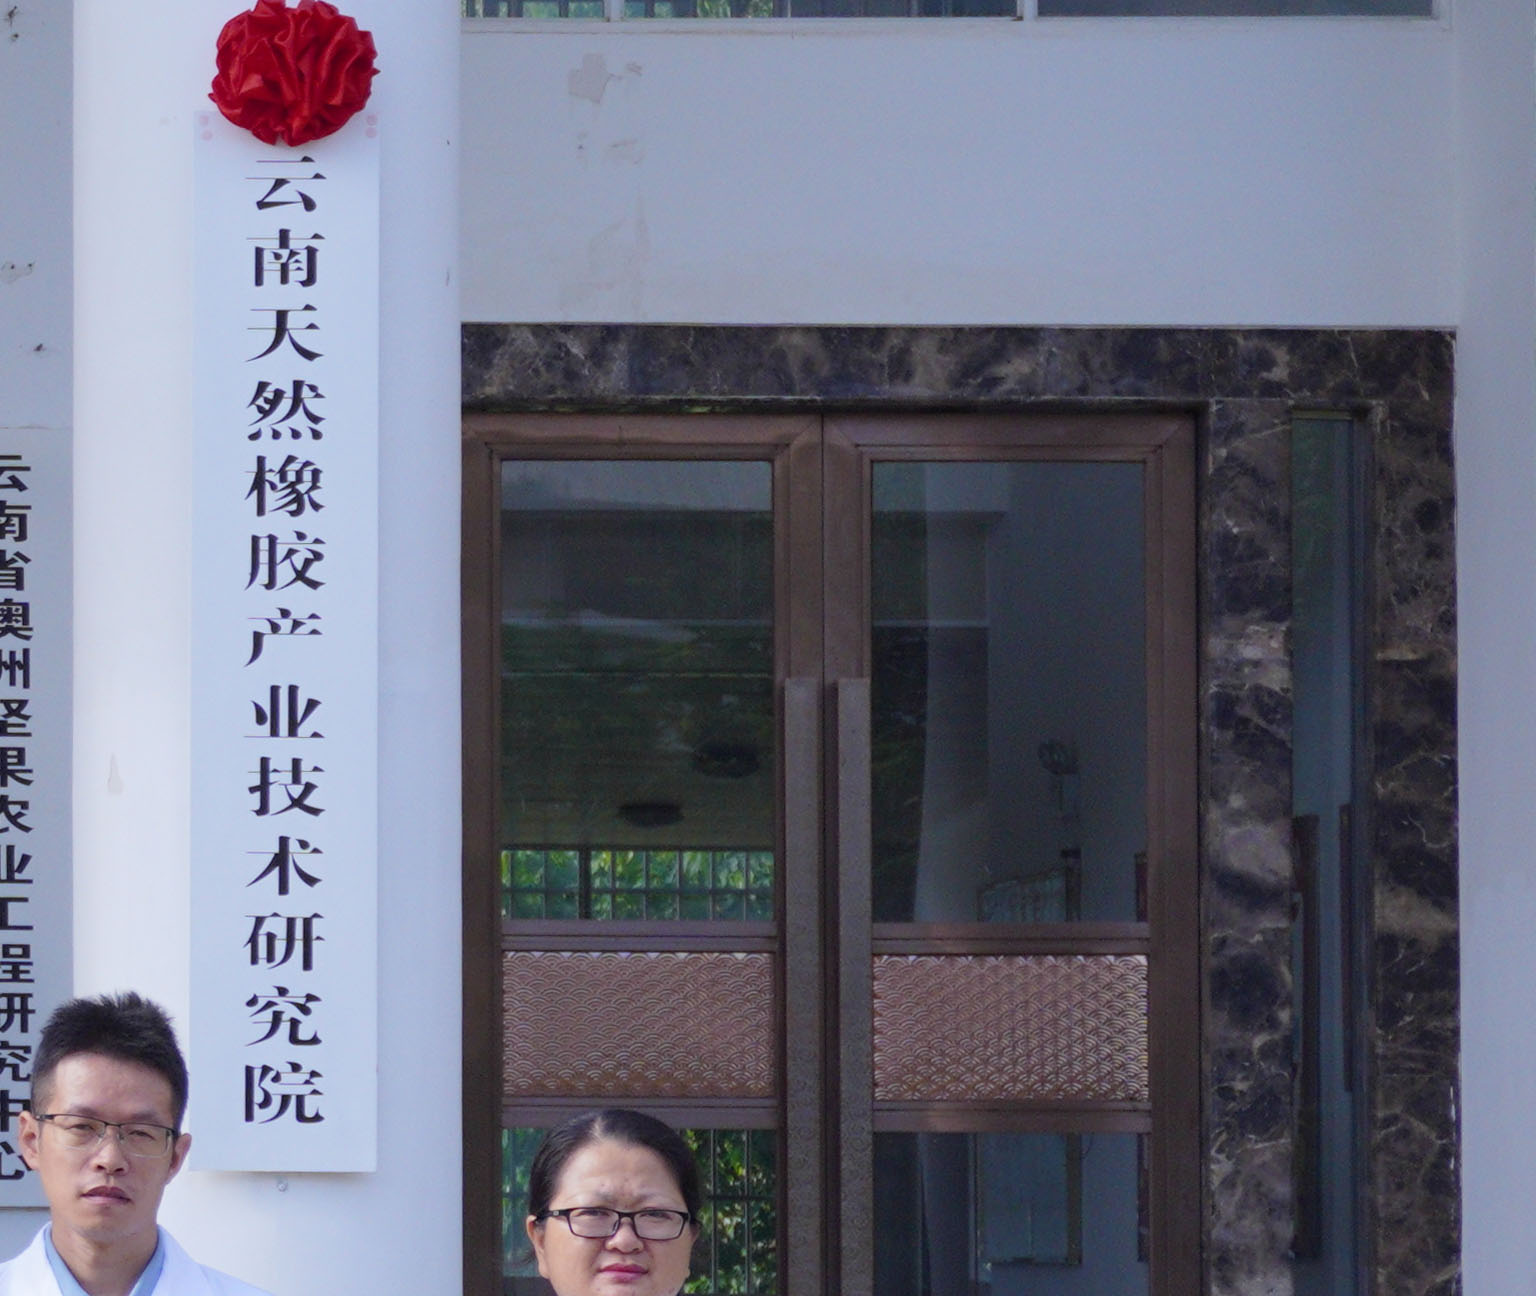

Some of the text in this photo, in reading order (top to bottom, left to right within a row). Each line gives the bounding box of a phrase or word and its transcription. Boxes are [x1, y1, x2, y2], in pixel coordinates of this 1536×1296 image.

[242, 154, 328, 1126] 云南天然橡胶产业技术研究院
